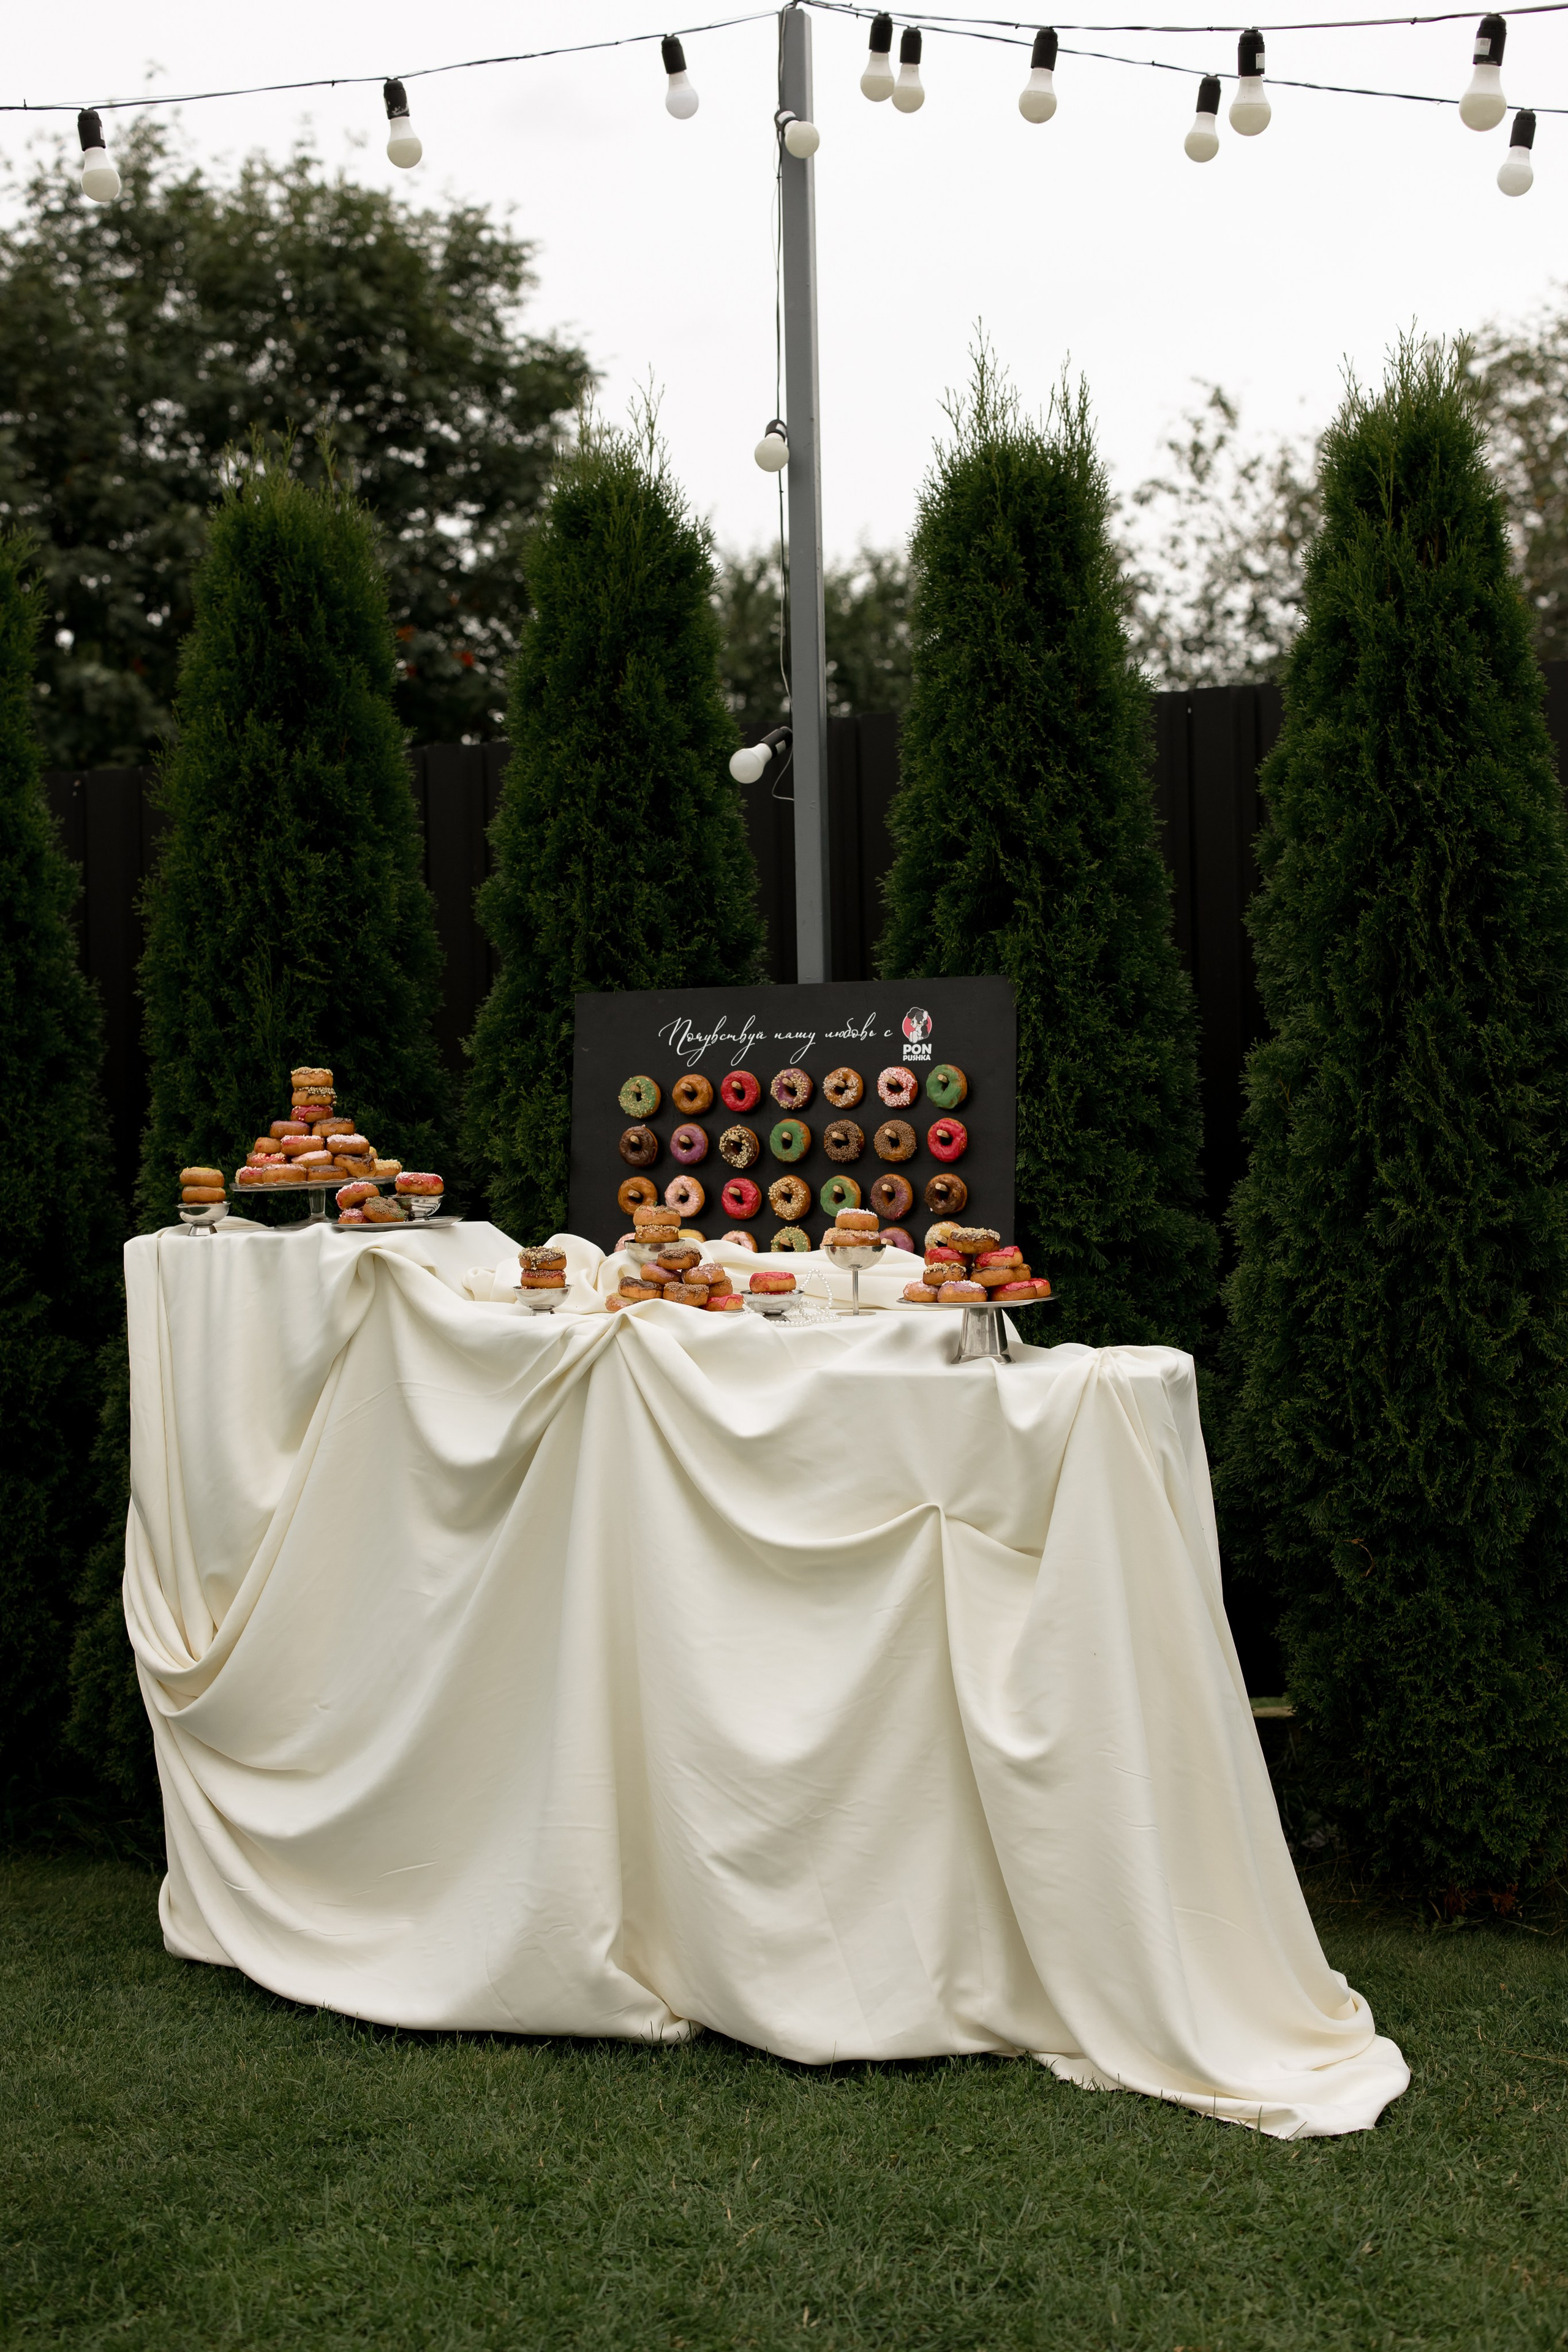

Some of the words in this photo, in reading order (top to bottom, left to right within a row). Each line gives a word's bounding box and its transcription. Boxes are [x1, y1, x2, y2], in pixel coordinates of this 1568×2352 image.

[658, 1015, 767, 1067] Почувствуй
[774, 1031, 816, 1065] нашу
[825, 1012, 877, 1041] любовь
[903, 1044, 932, 1055] PON
